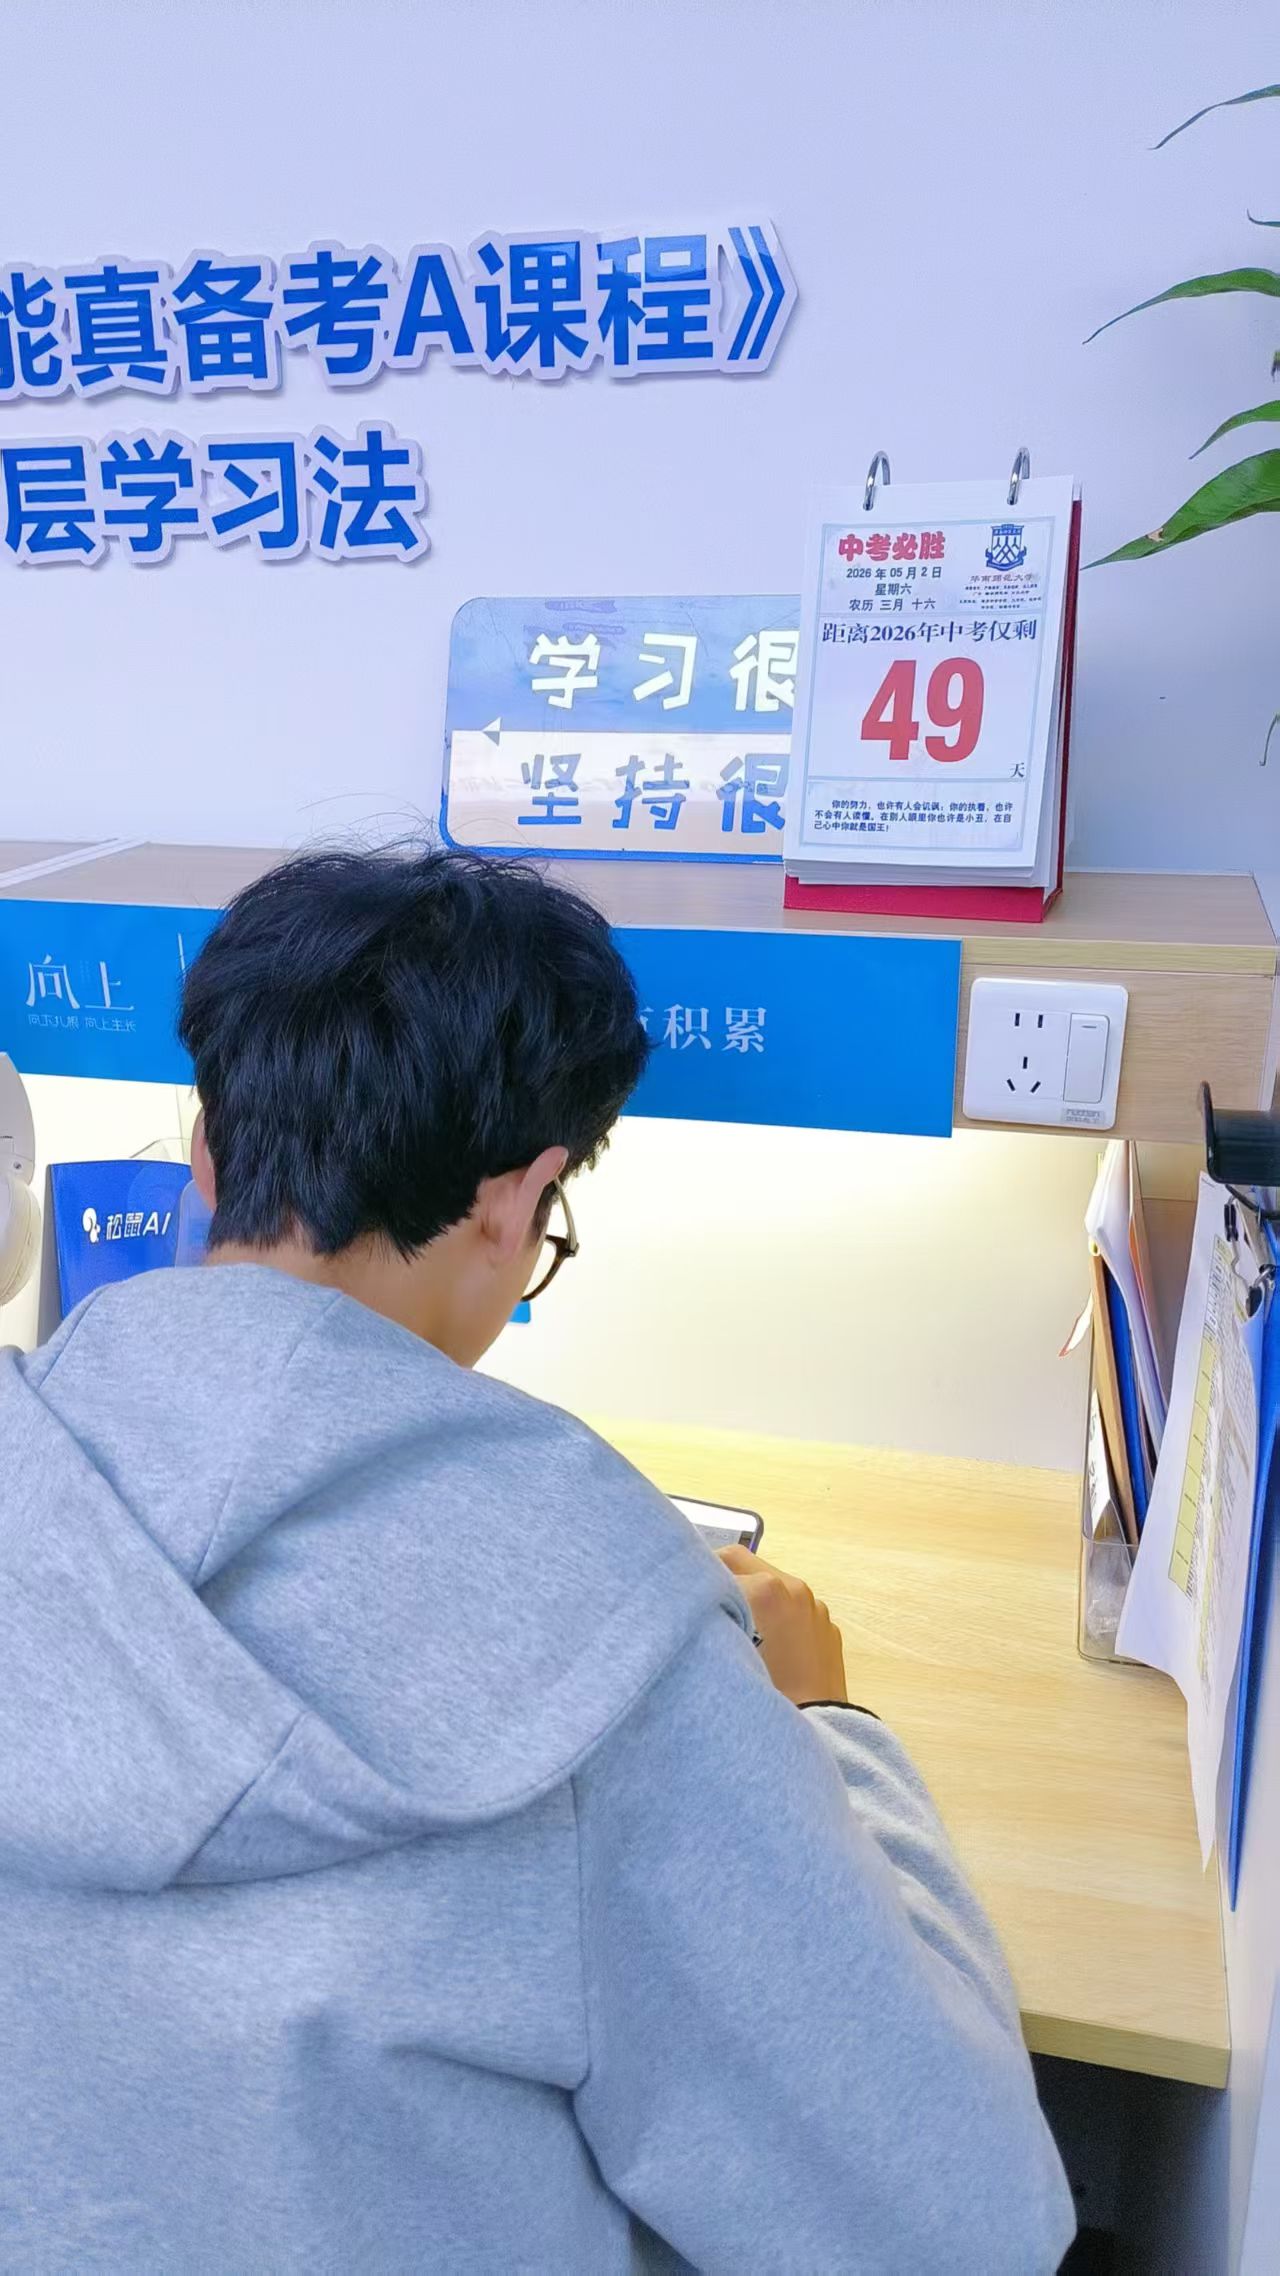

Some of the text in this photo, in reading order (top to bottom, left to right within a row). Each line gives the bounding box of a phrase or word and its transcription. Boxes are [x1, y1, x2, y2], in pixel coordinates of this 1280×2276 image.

[2, 431, 419, 555] 层学习法
[838, 531, 946, 562] 中考必胜
[875, 583, 912, 595] 星期六
[849, 598, 936, 612] 农历 三月 十六
[822, 619, 1038, 644] 距离2026年中考仅剩
[860, 656, 985, 763] 49
[1009, 762, 1025, 778] 天
[26, 954, 134, 1010] 向上
[106, 1211, 172, 1240] 松鼠AI
